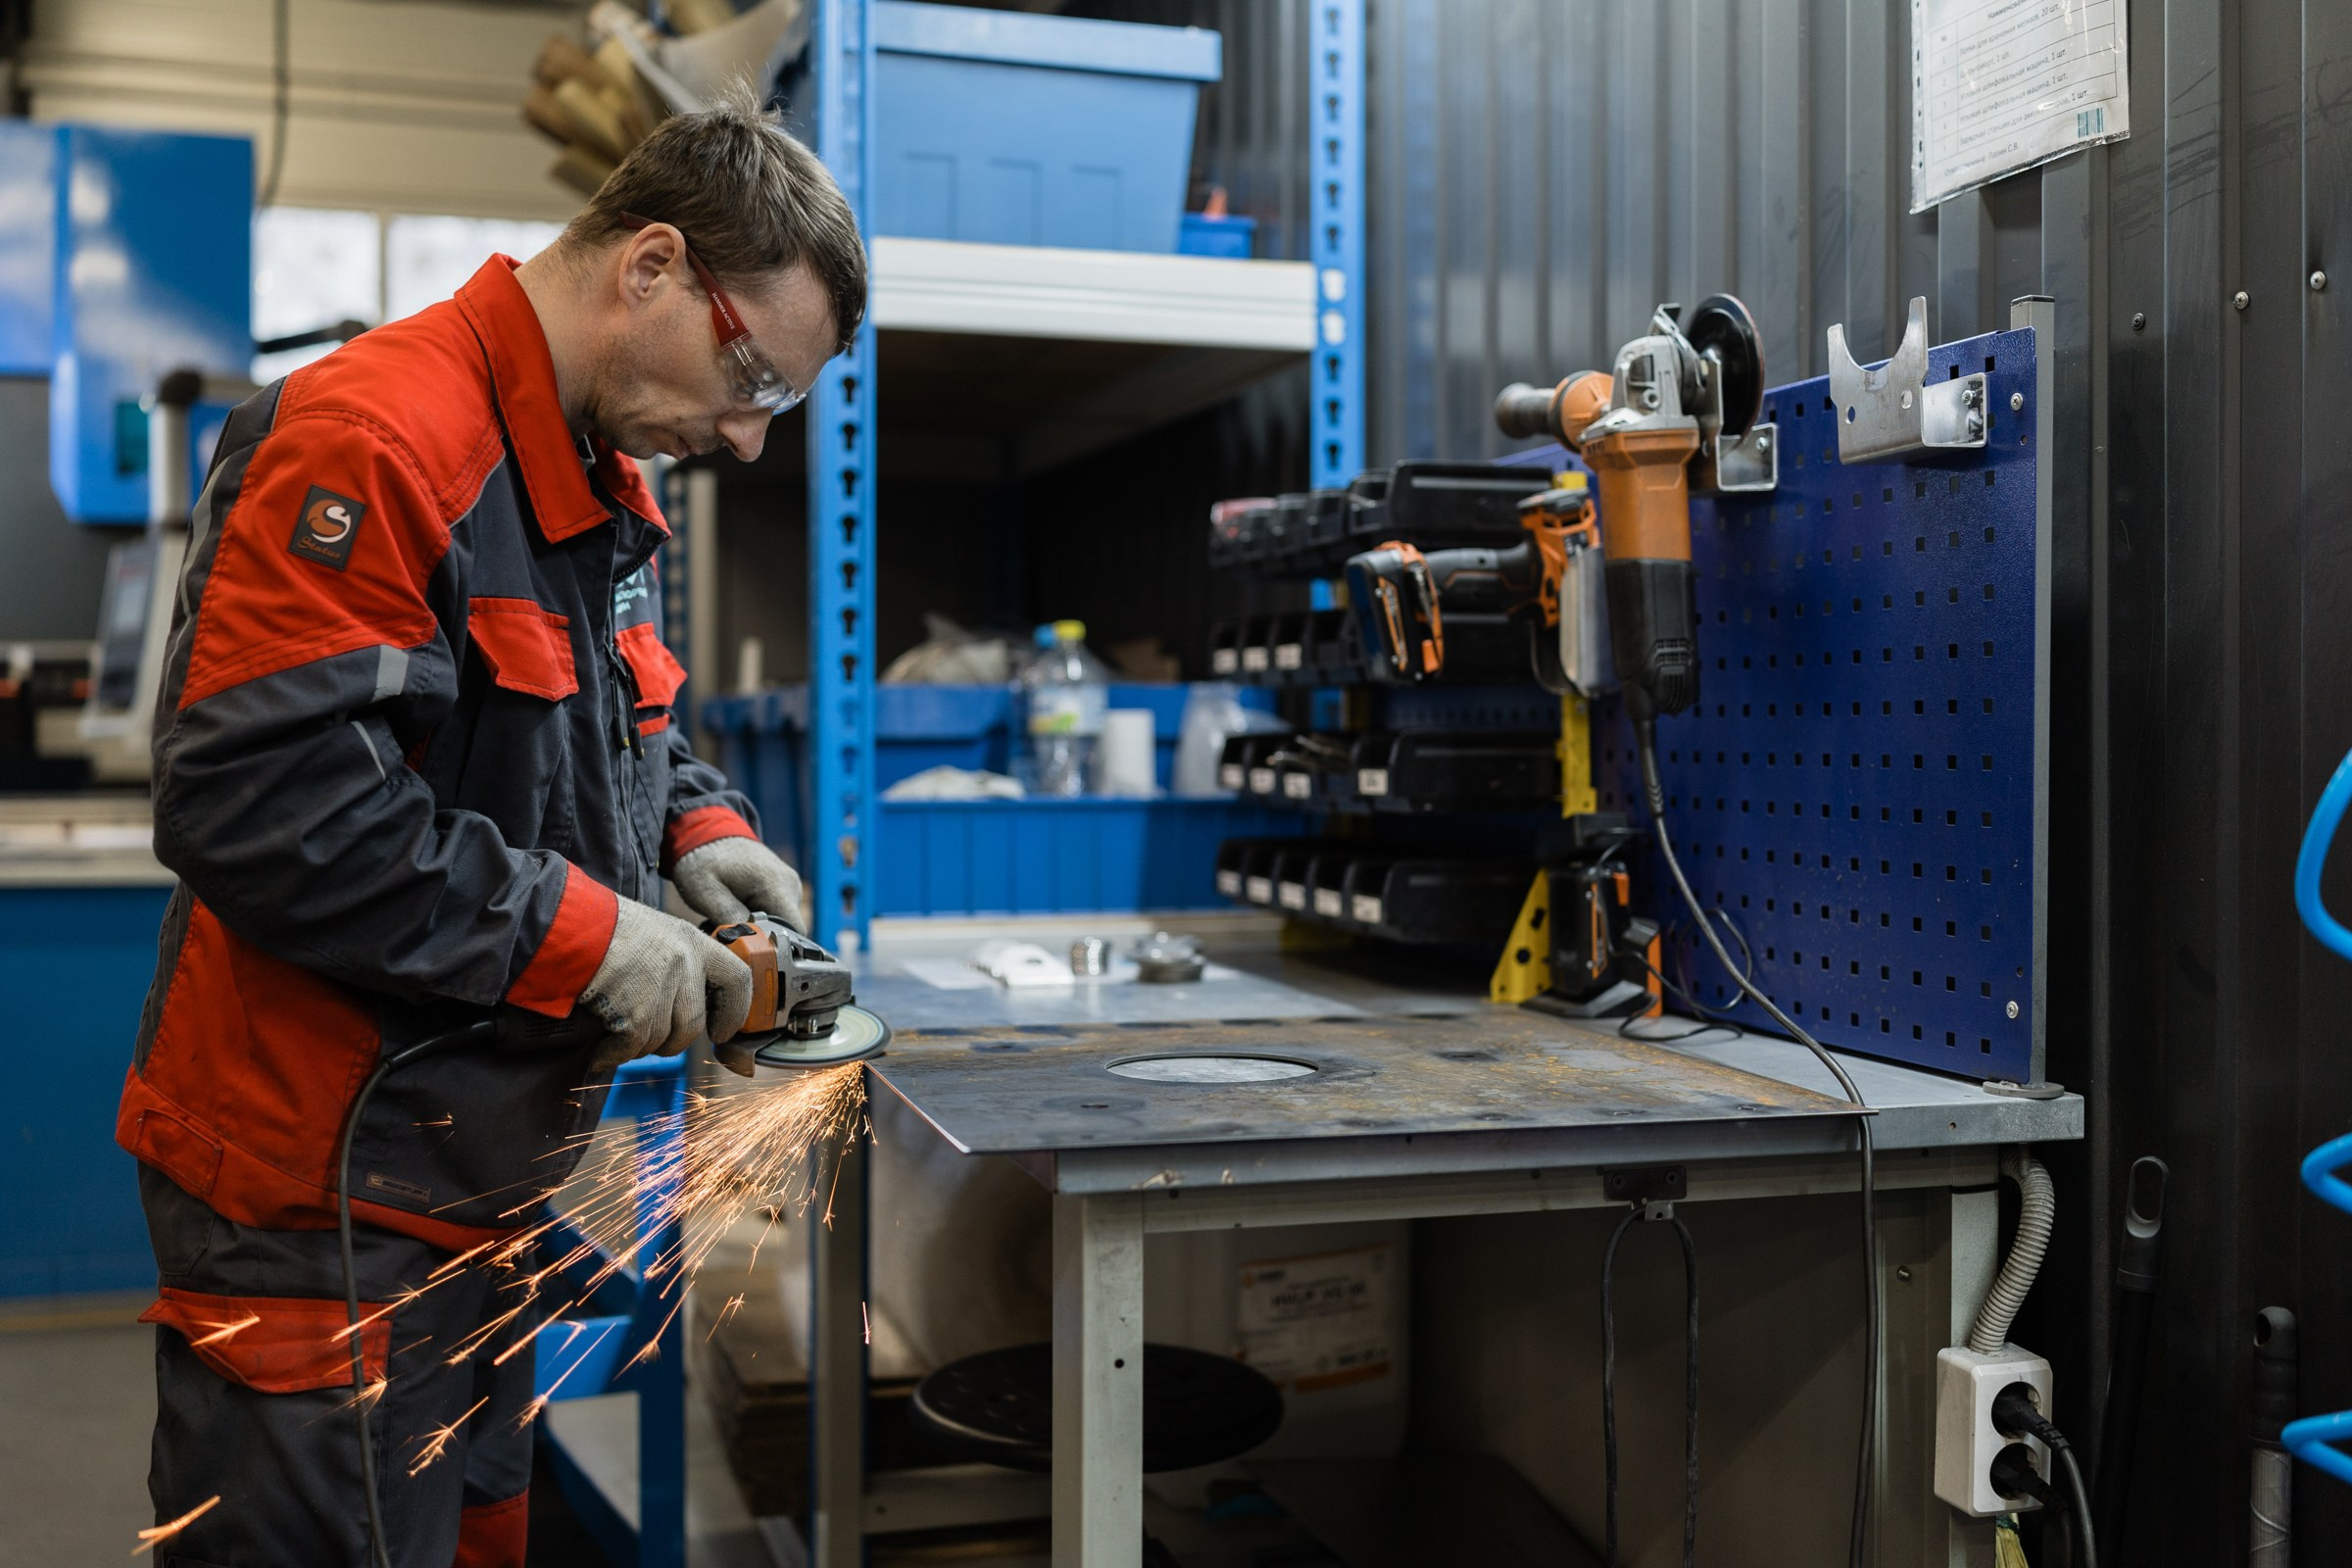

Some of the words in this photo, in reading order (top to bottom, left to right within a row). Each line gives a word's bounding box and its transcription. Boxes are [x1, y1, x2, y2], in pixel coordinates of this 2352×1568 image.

[1977, 39, 1987, 49] для
[1988, 25, 2016, 43] хранения
[2041, 7, 2049, 17] 20
[2049, 4, 2060, 14] шт.
[1982, 68, 2025, 91] шлифовальная
[2026, 56, 2050, 72] машина,
[2056, 49, 2067, 58] шт.
[2001, 51, 2011, 60] шт.
[1960, 110, 1982, 122] Угловая
[1982, 91, 2026, 114] шлифовальная
[2027, 80, 2050, 95] машина,
[2057, 73, 2068, 82] шт.
[1986, 121, 2011, 135] станция
[2011, 116, 2023, 125] для
[2077, 90, 2089, 99] шт.
[1987, 148, 2007, 159] Ларин
[2007, 142, 2019, 153] С.В.
[711, 292, 726, 314] HAMMER
[723, 313, 735, 330] ACTIVE
